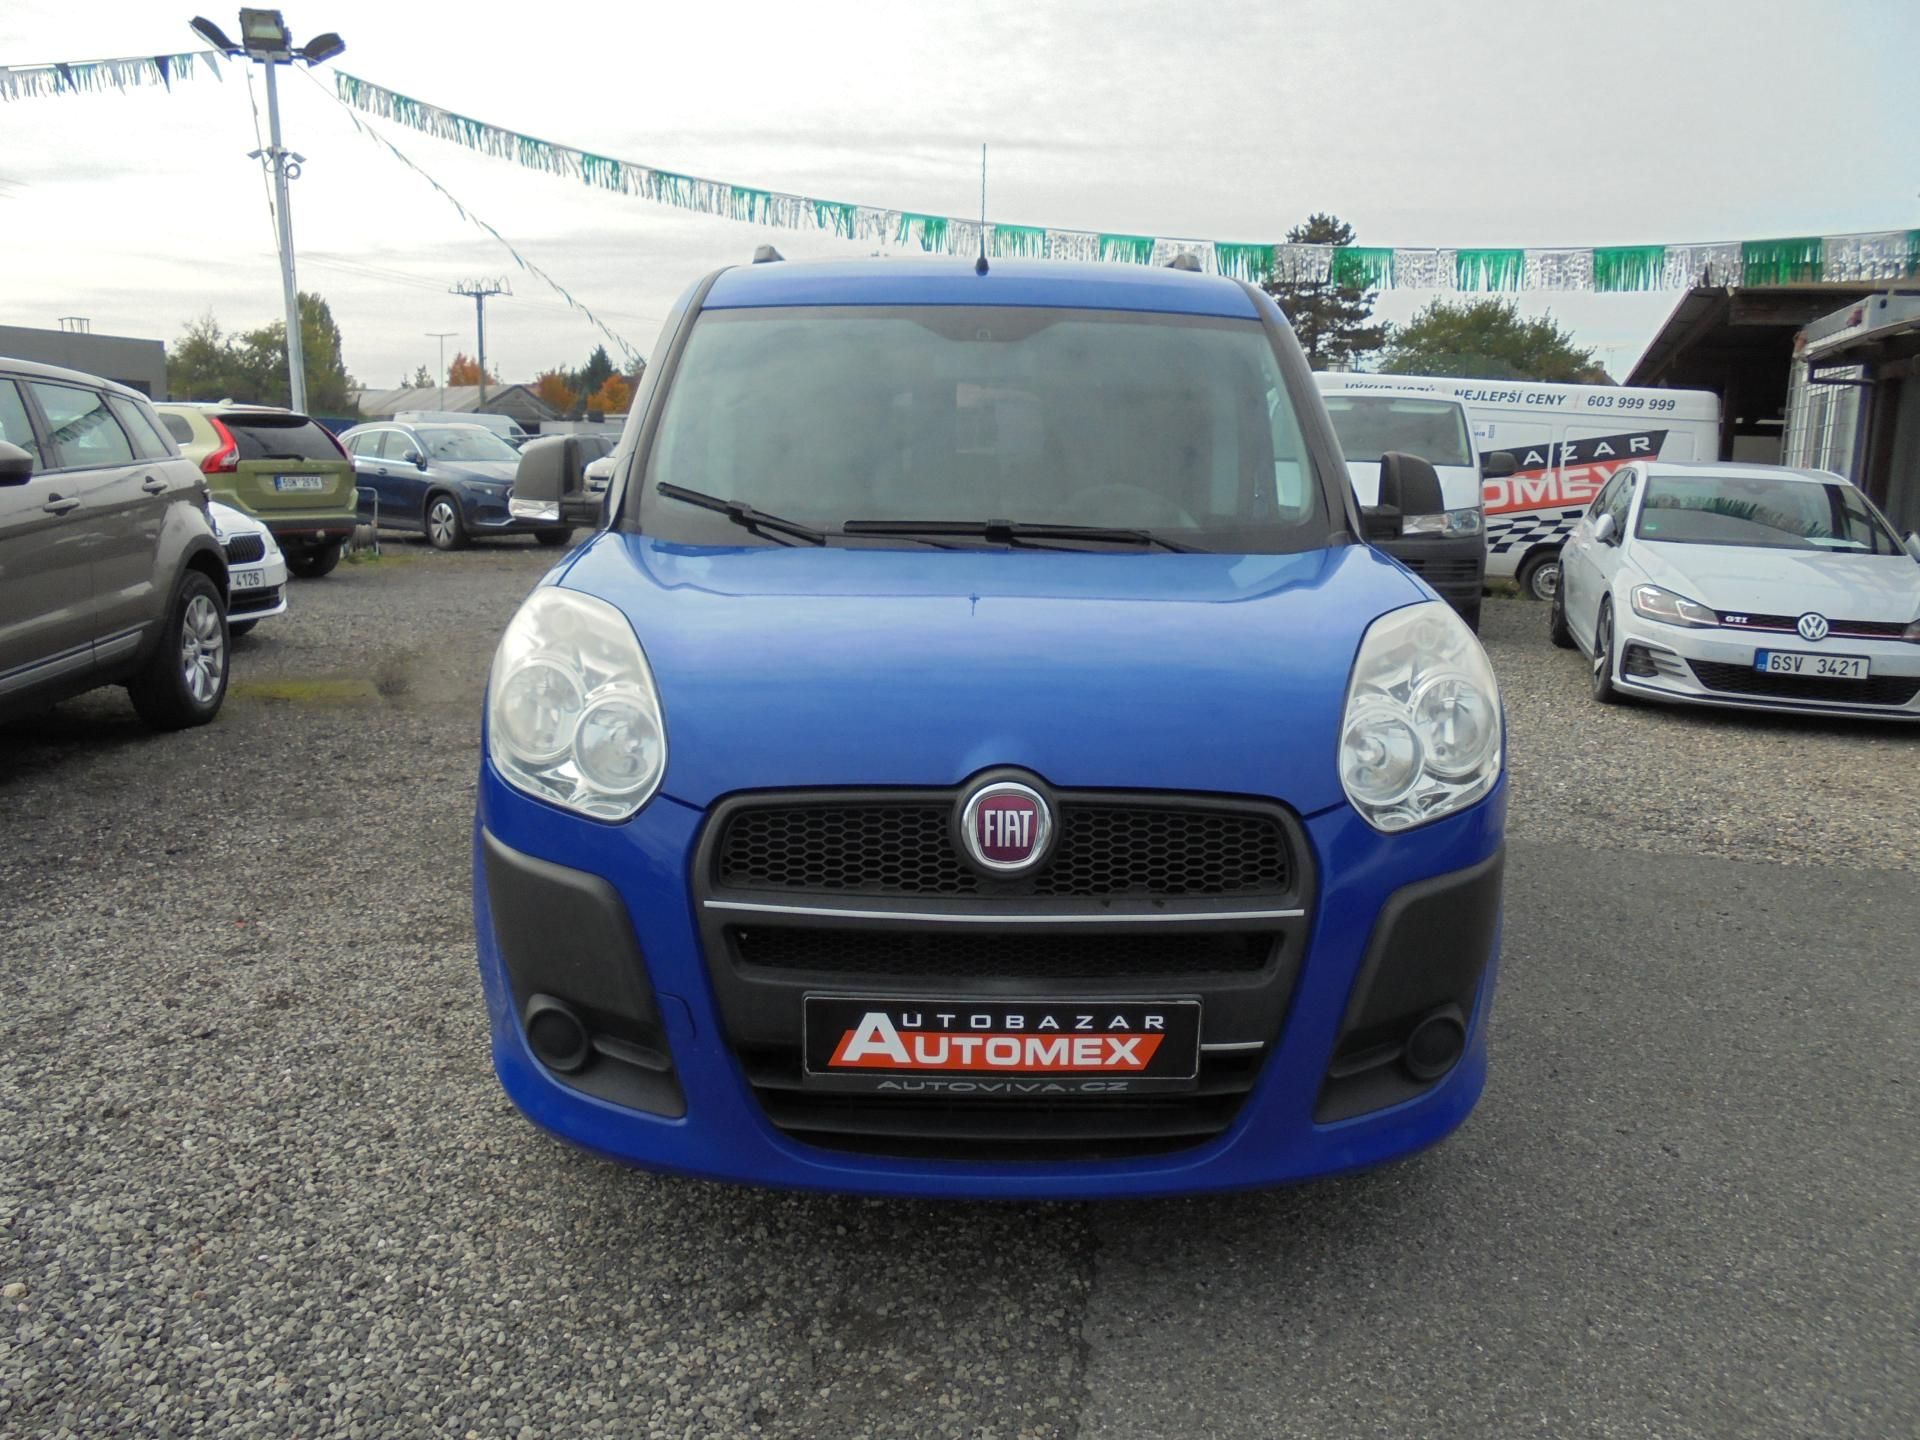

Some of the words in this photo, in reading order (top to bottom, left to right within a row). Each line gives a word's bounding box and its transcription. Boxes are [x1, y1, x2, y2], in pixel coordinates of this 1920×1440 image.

[1526, 393, 1567, 406] CENY
[1587, 395, 1614, 408] 603
[1617, 397, 1644, 409] 999
[1648, 398, 1676, 411] 999
[235, 571, 260, 588] 4126
[1725, 615, 1748, 624] GTI
[1771, 655, 1804, 673] 6SV
[1817, 658, 1859, 677] 3421
[984, 809, 1034, 848] FIAT
[841, 1011, 1143, 1067] AUTOMEX
[876, 1079, 1129, 1093] AUTOVIVA.CZ
